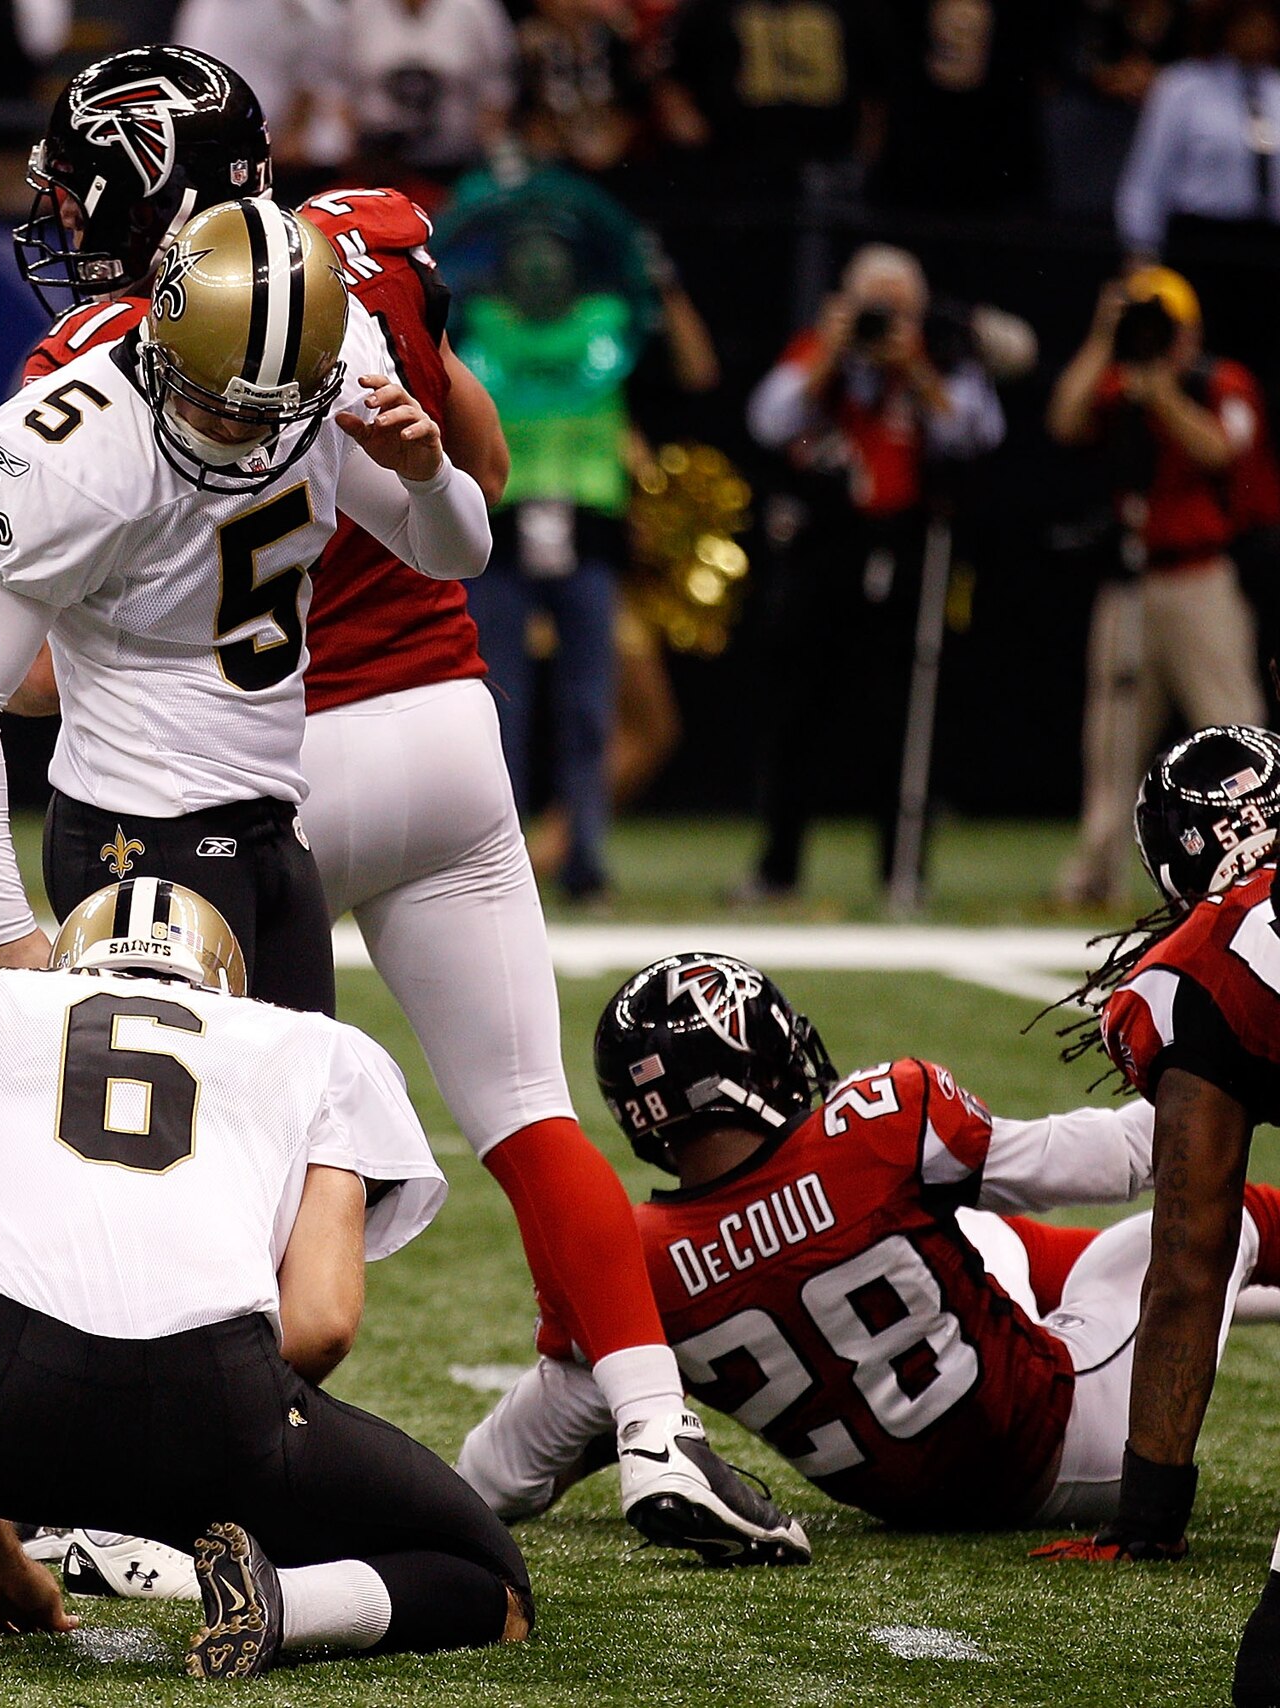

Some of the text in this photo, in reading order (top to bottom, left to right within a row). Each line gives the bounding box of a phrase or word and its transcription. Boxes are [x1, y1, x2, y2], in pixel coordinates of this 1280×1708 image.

[23, 379, 113, 444] 5
[243, 386, 284, 399] Riddell
[214, 479, 315, 692] 5
[1212, 804, 1267, 851] 53
[109, 939, 171, 957] SAINTS
[151, 921, 169, 940] 6
[53, 991, 207, 1176] 6
[624, 1090, 669, 1130] 28
[671, 1234, 979, 1478] 28
